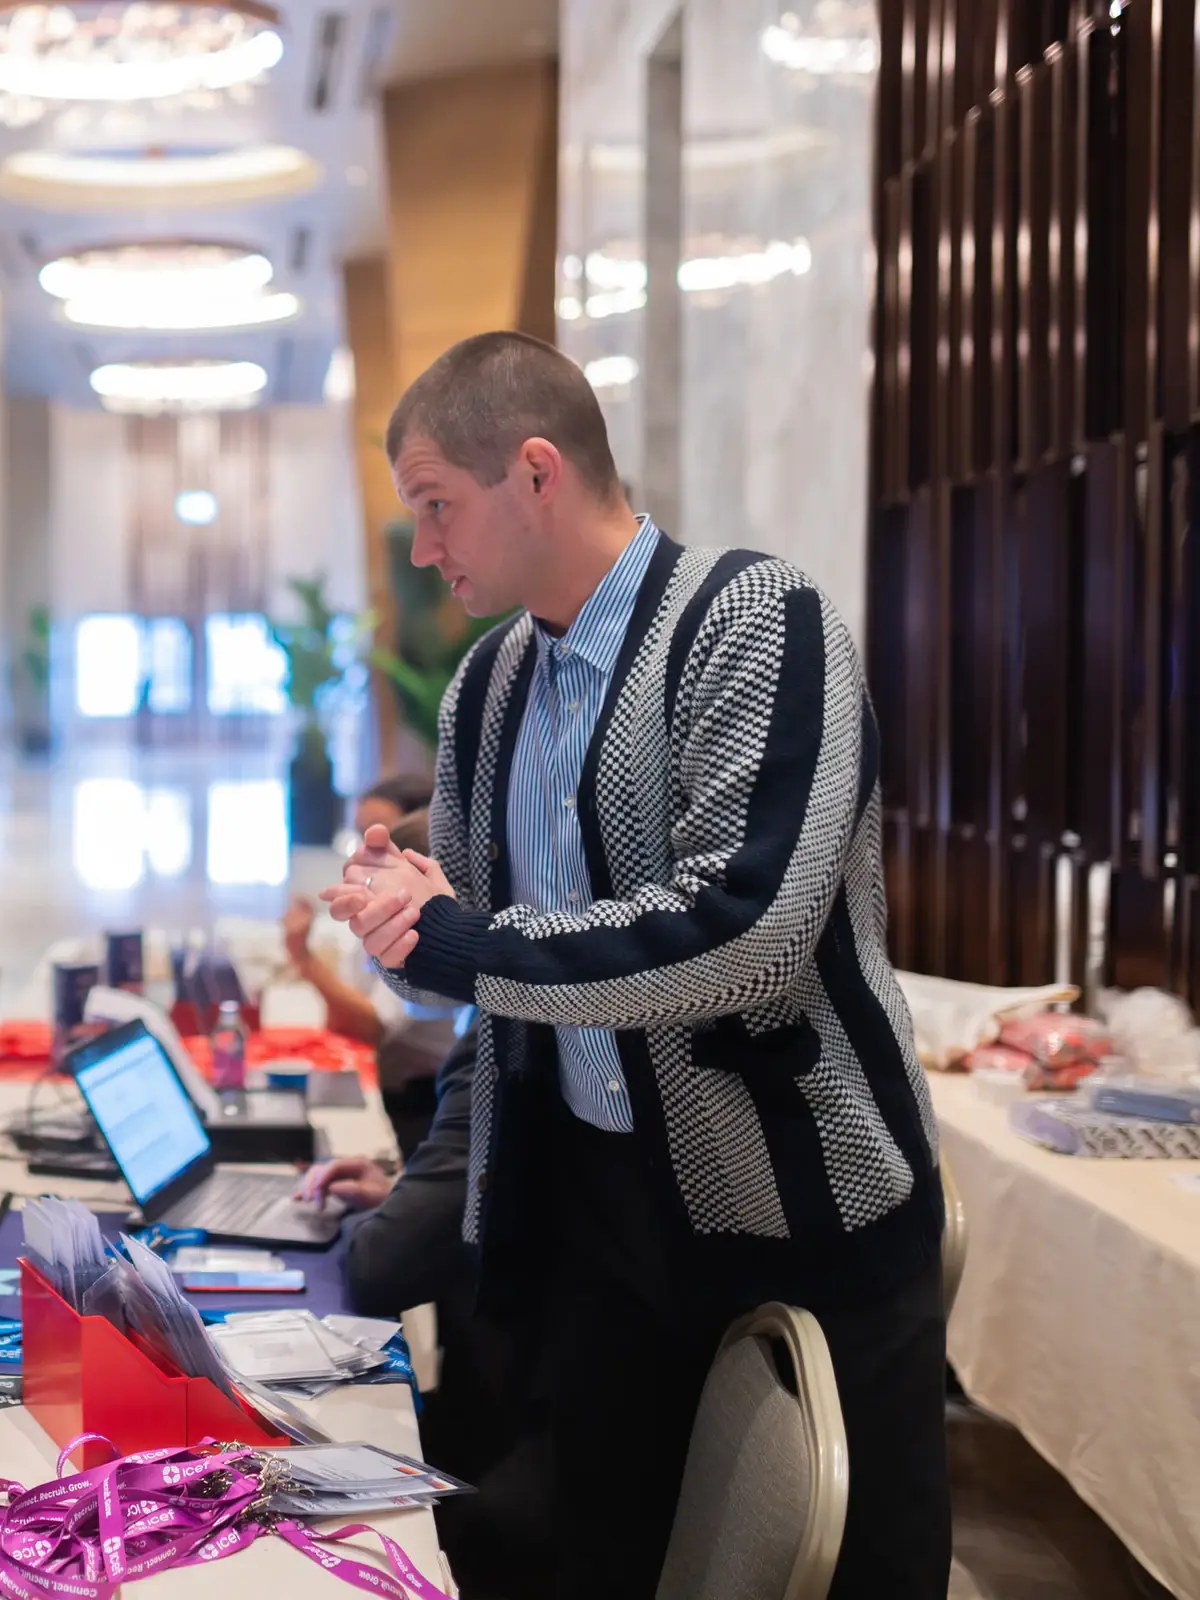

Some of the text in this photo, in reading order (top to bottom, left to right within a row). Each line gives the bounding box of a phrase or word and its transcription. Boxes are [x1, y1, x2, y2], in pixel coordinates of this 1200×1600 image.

[142, 1448, 169, 1460] icef
[182, 1460, 211, 1477] icef
[39, 1486, 69, 1501] Recruit.
[68, 1479, 93, 1493] Grow.
[147, 1508, 175, 1526] icef
[216, 1528, 241, 1550] icef
[12, 1546, 36, 1561] ice
